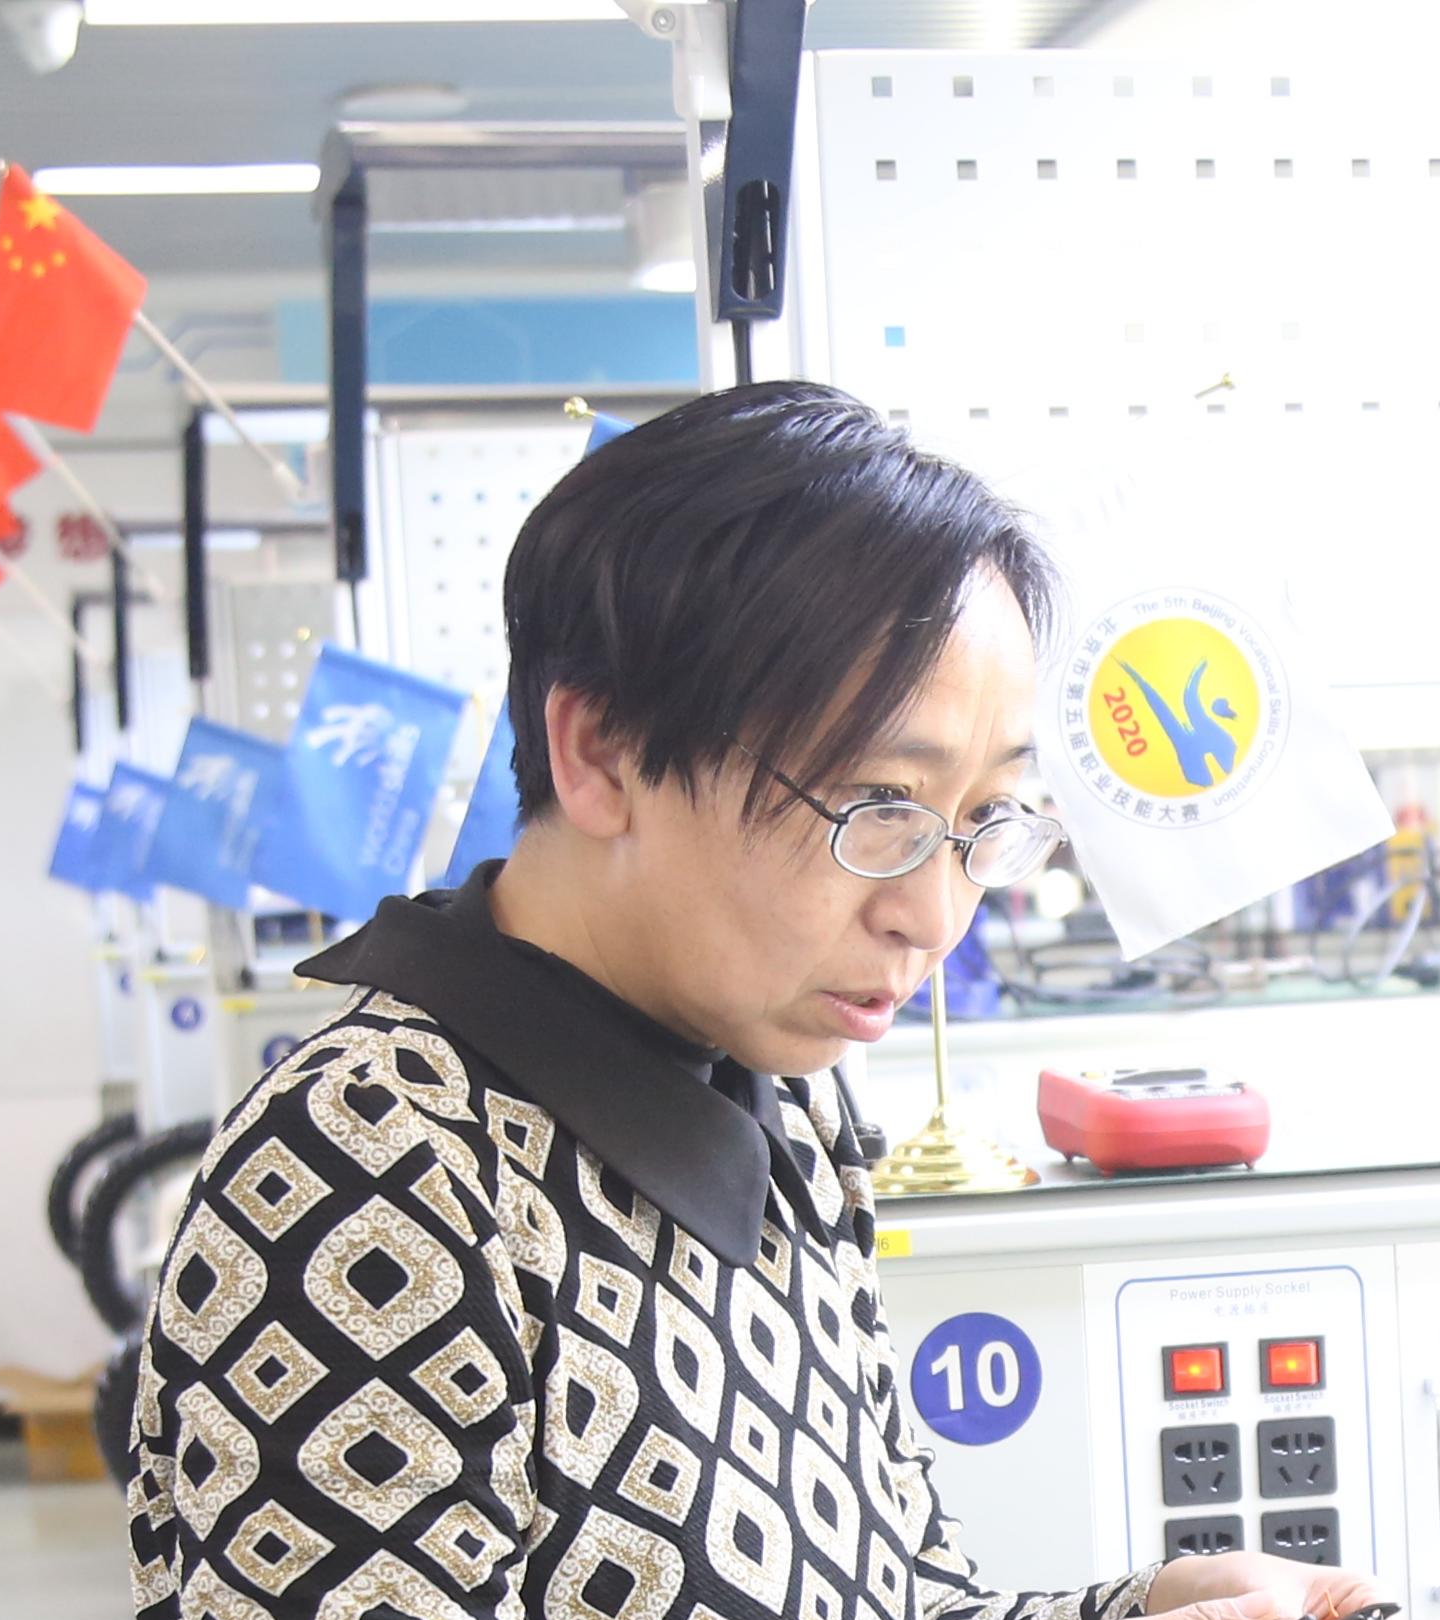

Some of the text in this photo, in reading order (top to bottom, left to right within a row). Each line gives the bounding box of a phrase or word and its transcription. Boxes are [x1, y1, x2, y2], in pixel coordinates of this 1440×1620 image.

[1065, 616, 1201, 824] 北京市第五届职业技能大赛
[1102, 686, 1149, 758] 2020
[1132, 596, 1282, 807] The 5th Beijing Vocational Skills Competition
[1169, 1280, 1311, 1302] Power Supply Socket
[931, 1340, 1021, 1412] 10
[1168, 1400, 1199, 1411] Socket
[1264, 1393, 1295, 1405] Socket
